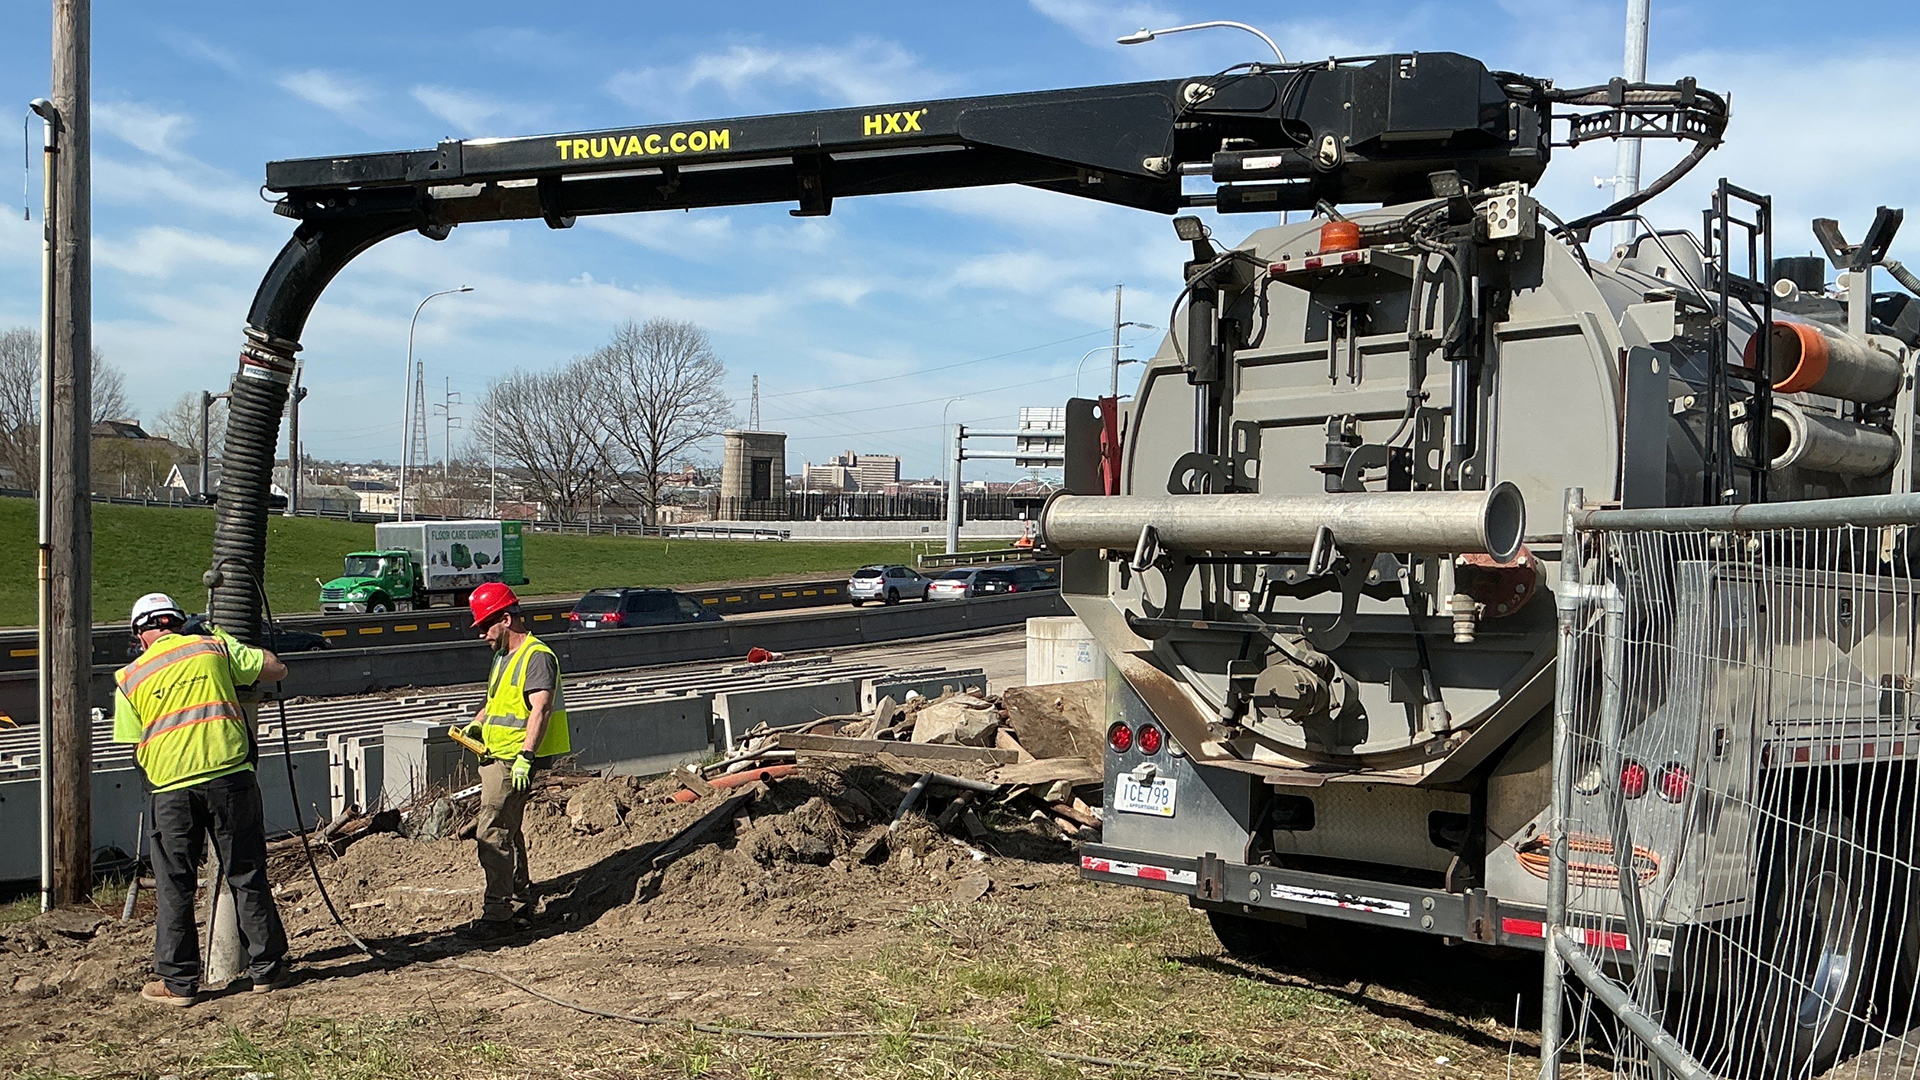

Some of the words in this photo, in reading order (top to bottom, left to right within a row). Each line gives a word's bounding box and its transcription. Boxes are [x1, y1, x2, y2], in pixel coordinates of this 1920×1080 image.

[556, 129, 730, 160] TRUVAC.COM
[431, 530, 450, 540] FLOOR
[451, 530, 466, 540] CARE
[468, 529, 499, 539] EQUIPMENT
